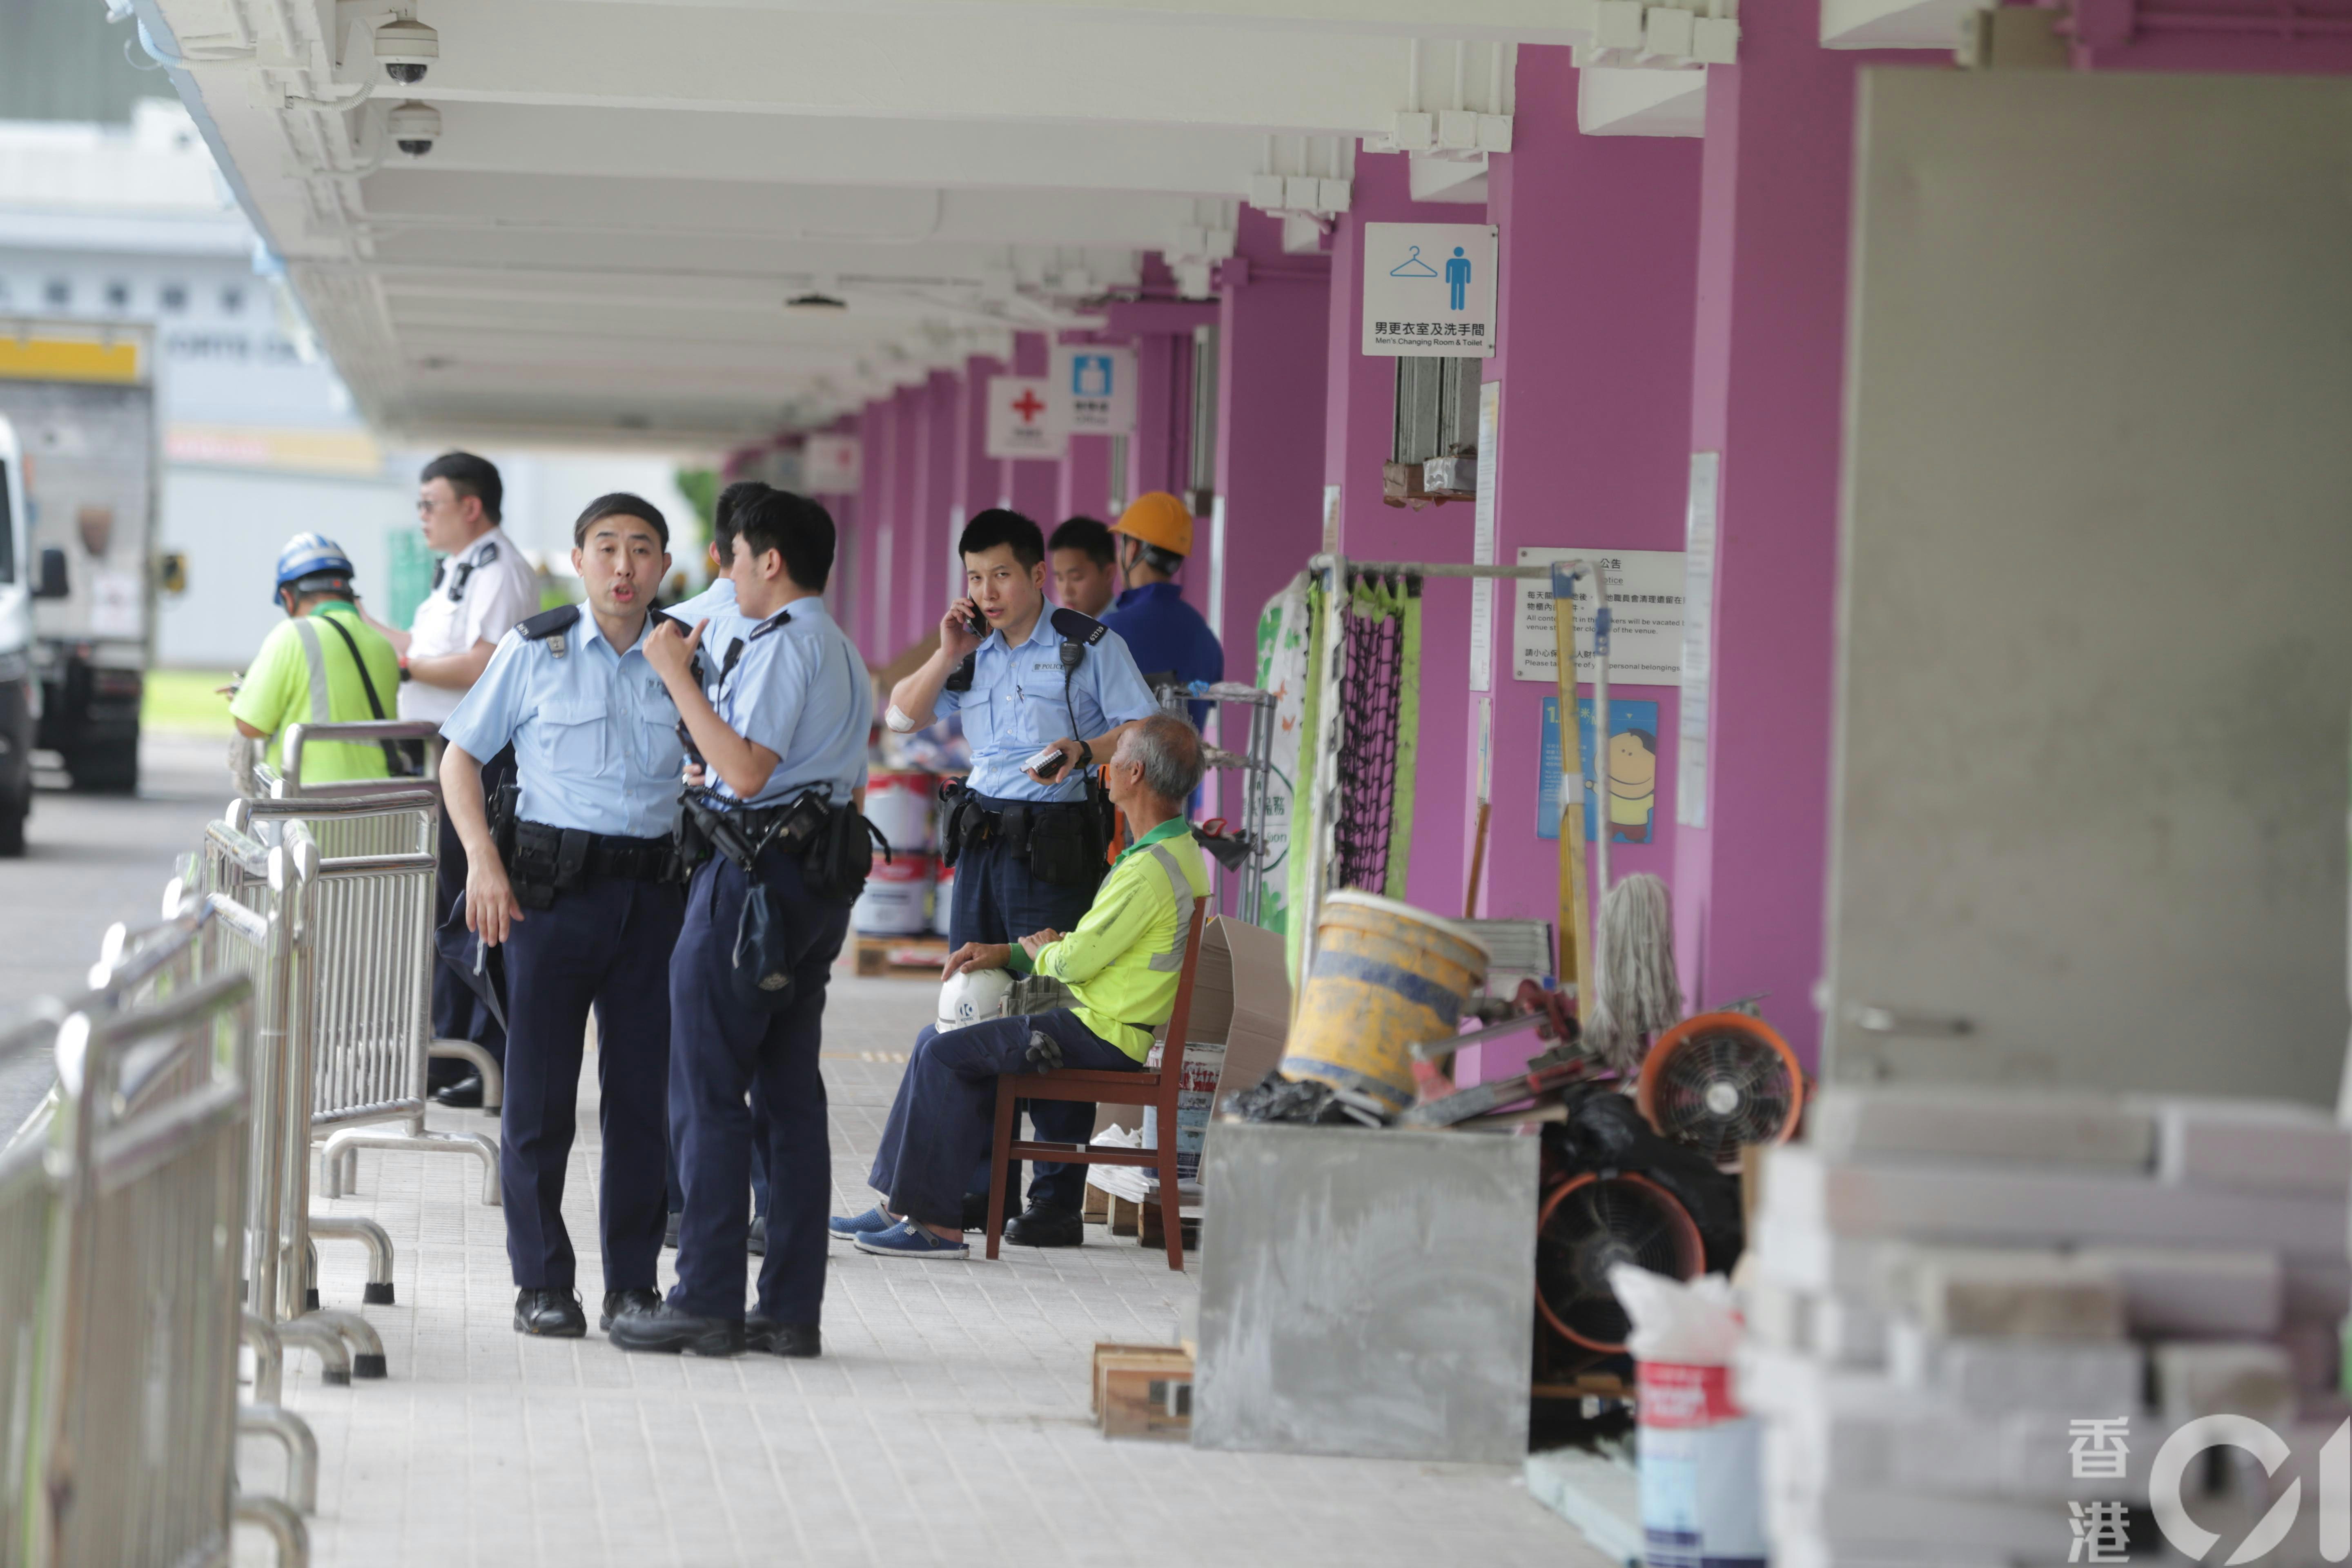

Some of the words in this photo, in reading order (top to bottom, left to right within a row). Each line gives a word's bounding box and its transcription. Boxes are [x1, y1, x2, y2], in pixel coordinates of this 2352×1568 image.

[1375, 322, 1484, 336] 男更衣室及洗手間
[1600, 558, 1621, 569] 公告
[1089, 626, 1104, 641] 62739
